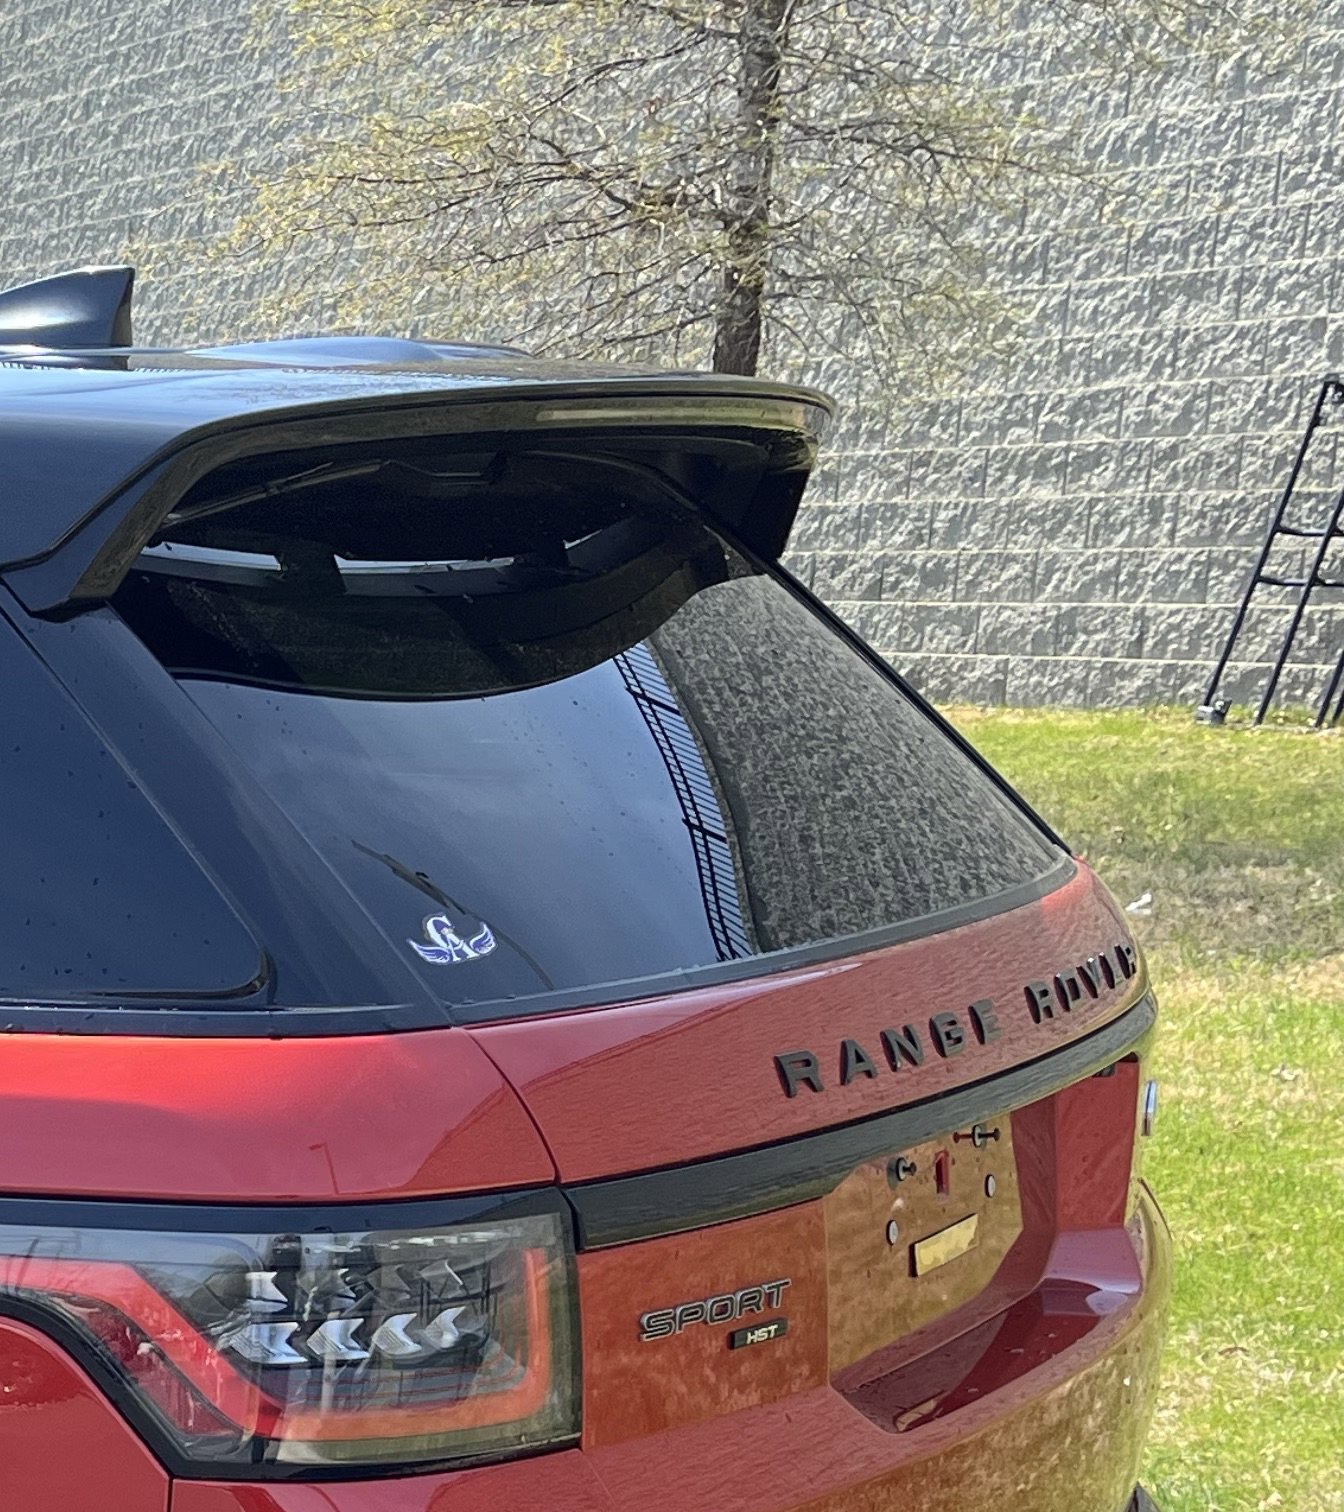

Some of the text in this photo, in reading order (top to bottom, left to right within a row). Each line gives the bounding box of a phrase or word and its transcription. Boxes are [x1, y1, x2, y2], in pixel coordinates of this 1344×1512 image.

[774, 944, 1138, 1098] RANGE ROVER
[640, 1279, 792, 1342] SPORT
[746, 1324, 779, 1345] HST
